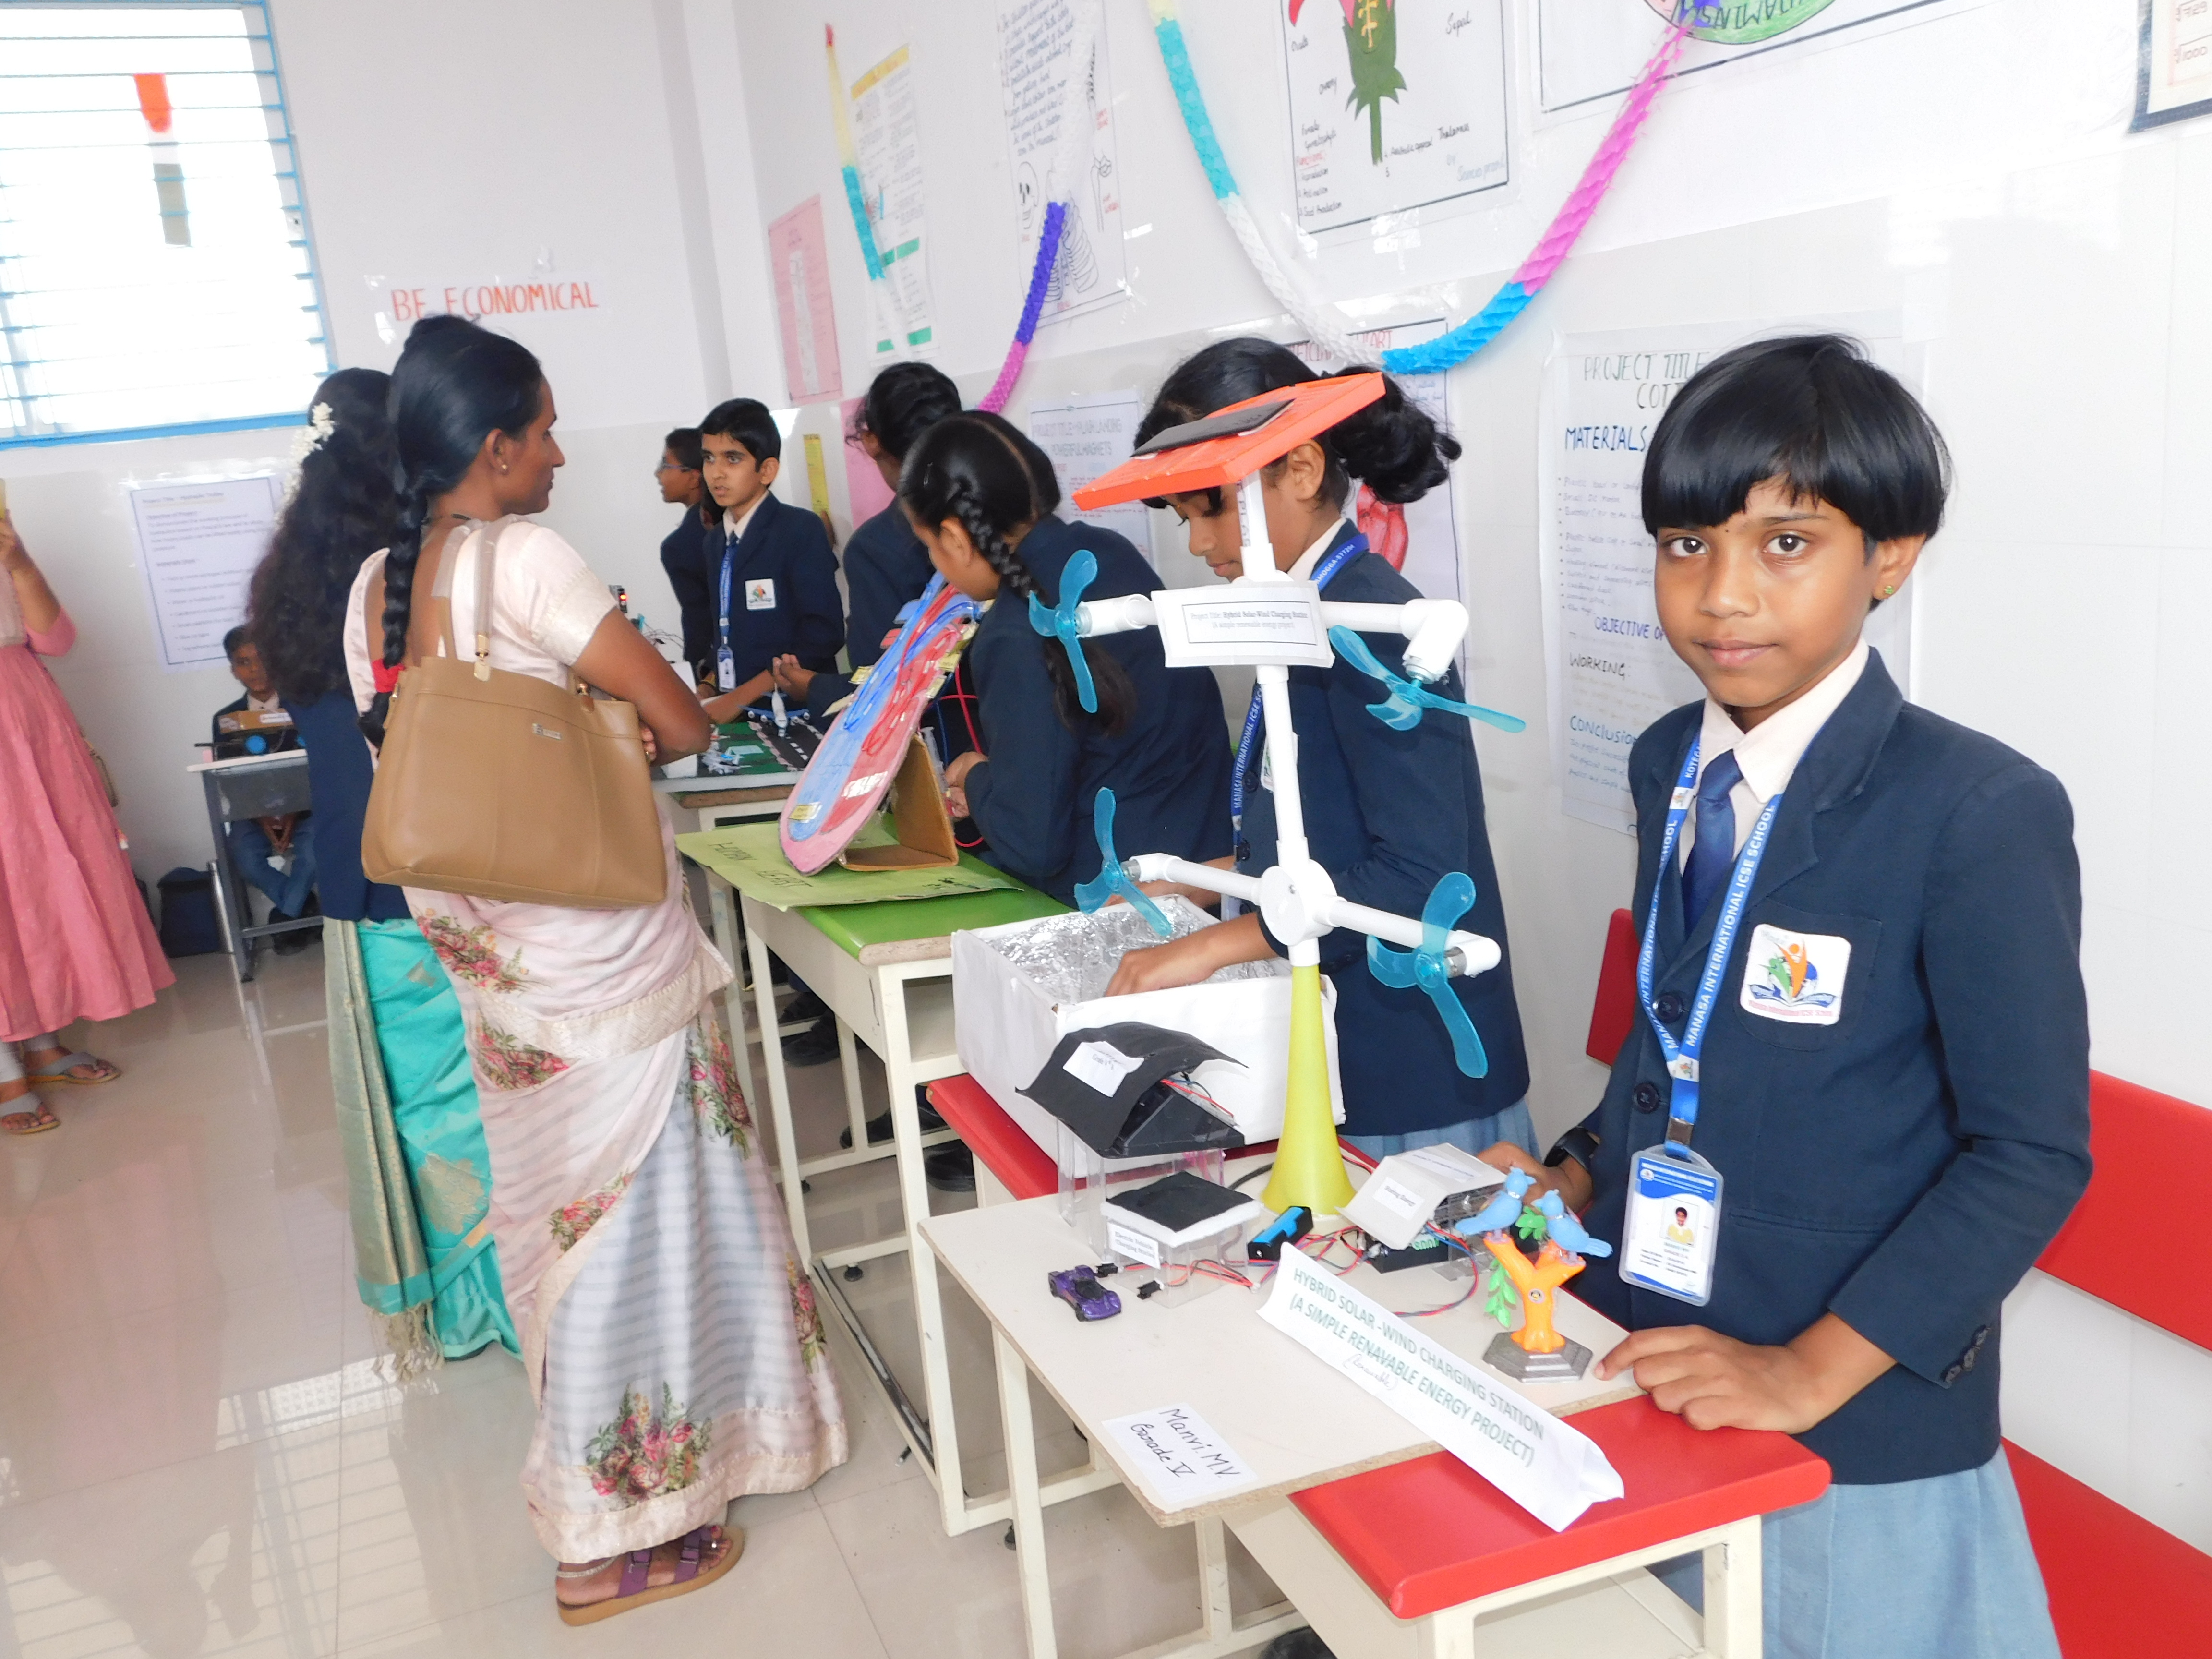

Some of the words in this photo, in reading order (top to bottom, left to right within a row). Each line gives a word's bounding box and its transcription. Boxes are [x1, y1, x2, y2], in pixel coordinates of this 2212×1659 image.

[391, 289, 426, 322] BE
[444, 281, 599, 318] ECONOMICAL
[1584, 353, 1658, 381] PROJECT
[1564, 425, 1647, 452] MATERIALS
[1594, 616, 1650, 639] OBJECTIVE
[1235, 723, 1254, 778] INTERNATIONAL
[1704, 892, 1744, 993] INTERNATIONAL
[1746, 805, 1776, 858] SCHOOL
[1294, 1268, 1336, 1303] HYBRID
[1338, 1295, 1376, 1330] SOLAR
[1419, 1346, 1487, 1401] CHARGING
[1489, 1392, 1545, 1441] STATION
[1289, 1293, 1305, 1313] (A
[1304, 1303, 1349, 1340] SIMPLE
[1347, 1330, 1419, 1386] RENAVABLE
[1418, 1376, 1472, 1419] ENERGY
[1470, 1411, 1535, 1468] PROJECT)
